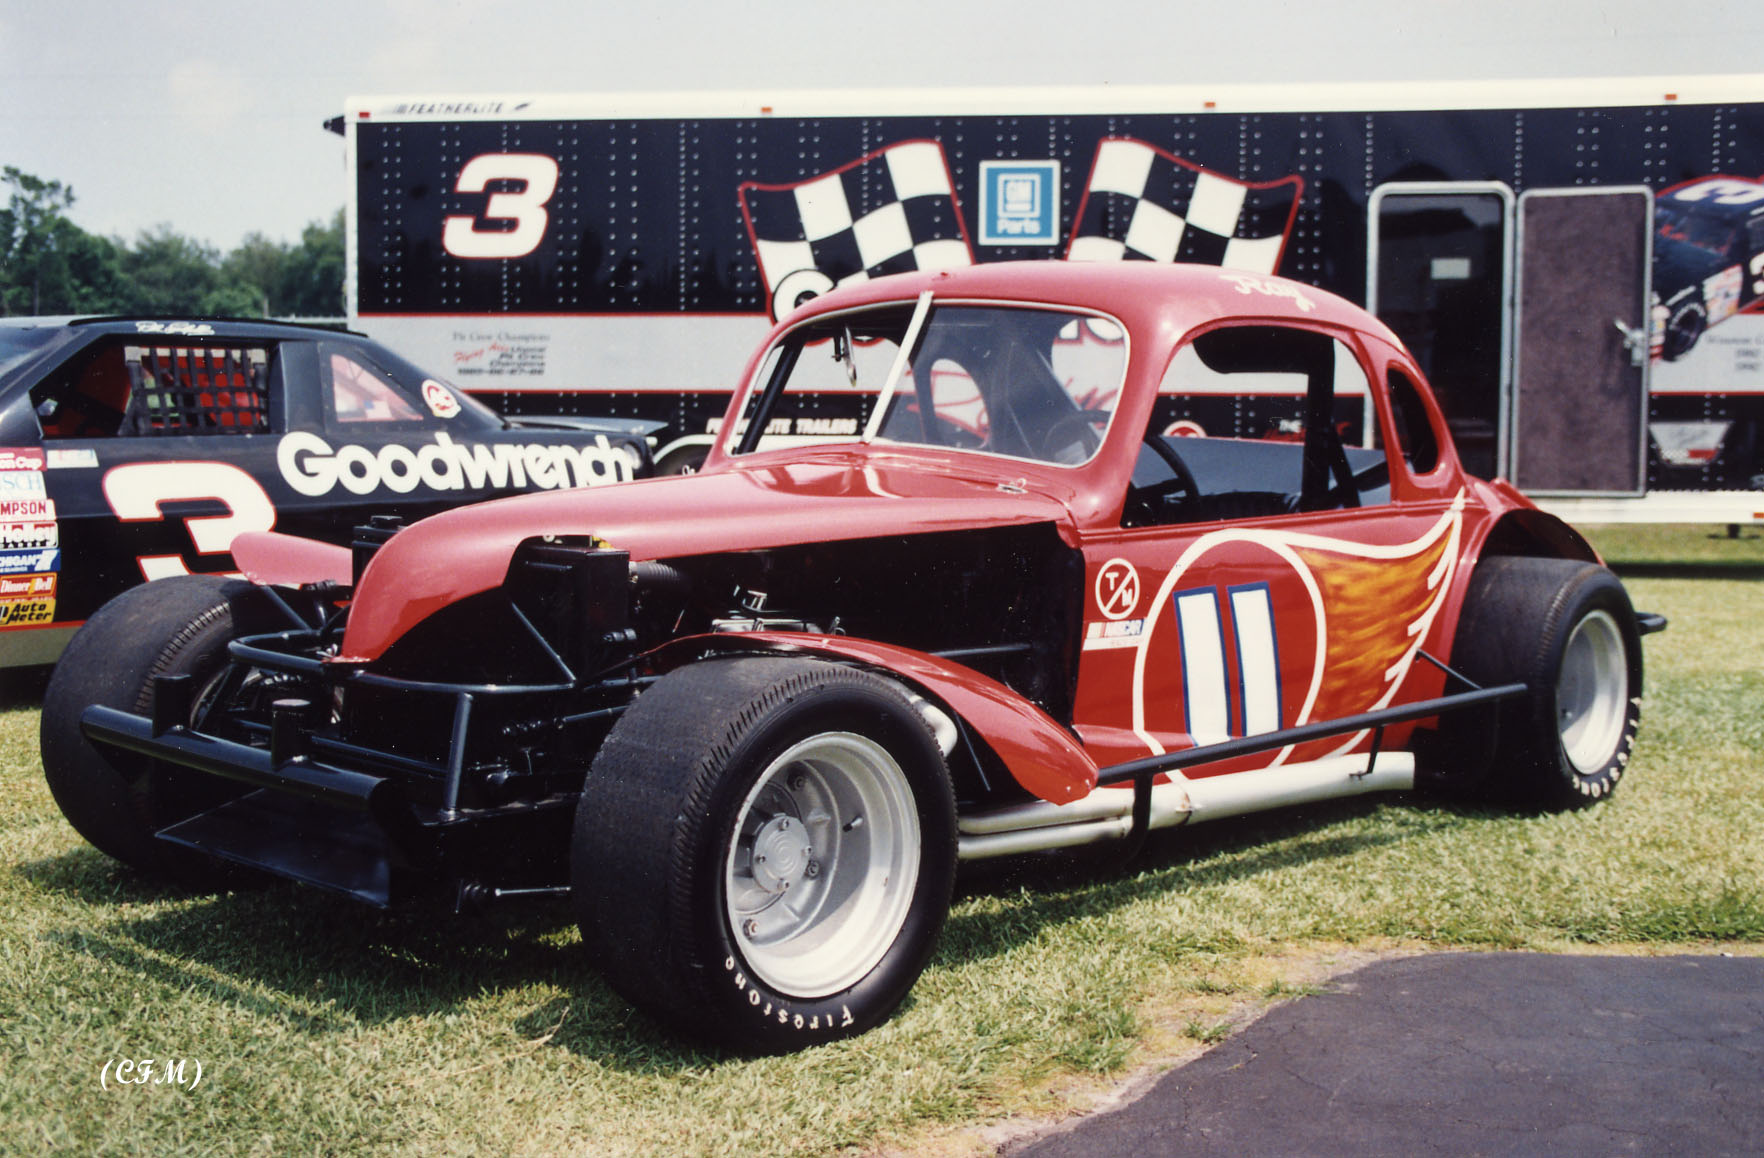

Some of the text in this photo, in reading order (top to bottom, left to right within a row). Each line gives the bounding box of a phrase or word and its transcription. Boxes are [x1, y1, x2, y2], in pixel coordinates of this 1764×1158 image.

[442, 152, 560, 259] 3
[997, 217, 1042, 235] Parts
[2, 473, 42, 490] SCH
[277, 431, 634, 496] Goodwrench
[102, 461, 277, 586] 3
